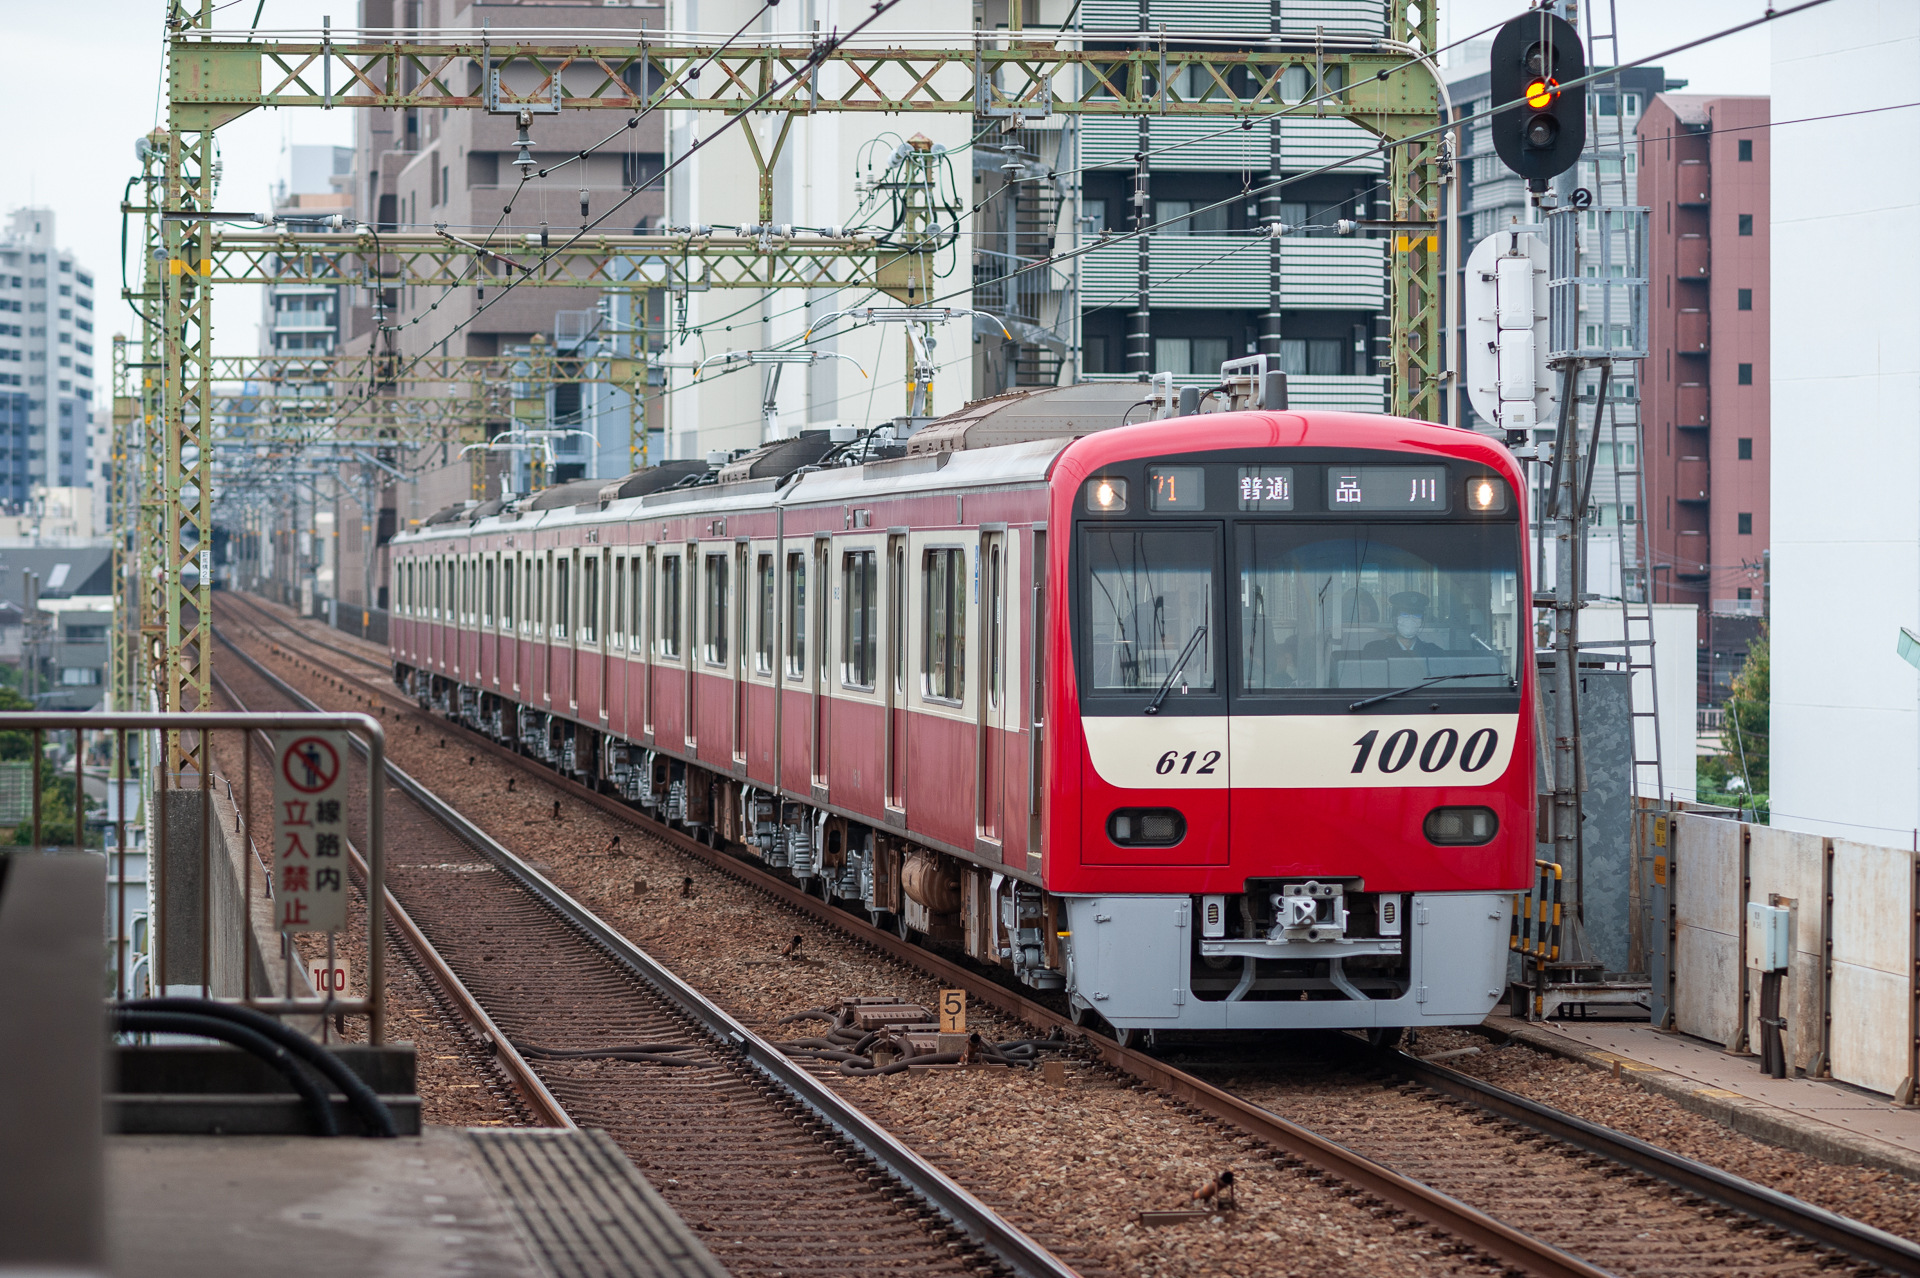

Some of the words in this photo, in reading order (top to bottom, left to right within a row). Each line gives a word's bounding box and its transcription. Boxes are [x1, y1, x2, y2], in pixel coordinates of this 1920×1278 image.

[1576, 190, 1588, 207] 2
[1240, 476, 1289, 501] 普通
[1335, 475, 1436, 502] 品川
[1155, 750, 1221, 775] 612
[1350, 727, 1499, 774] 1000
[315, 798, 341, 892] 線路内
[282, 799, 310, 925] 立入禁止
[314, 968, 345, 991] 100
[944, 993, 962, 1015] 5
[949, 1016, 956, 1031] 1
